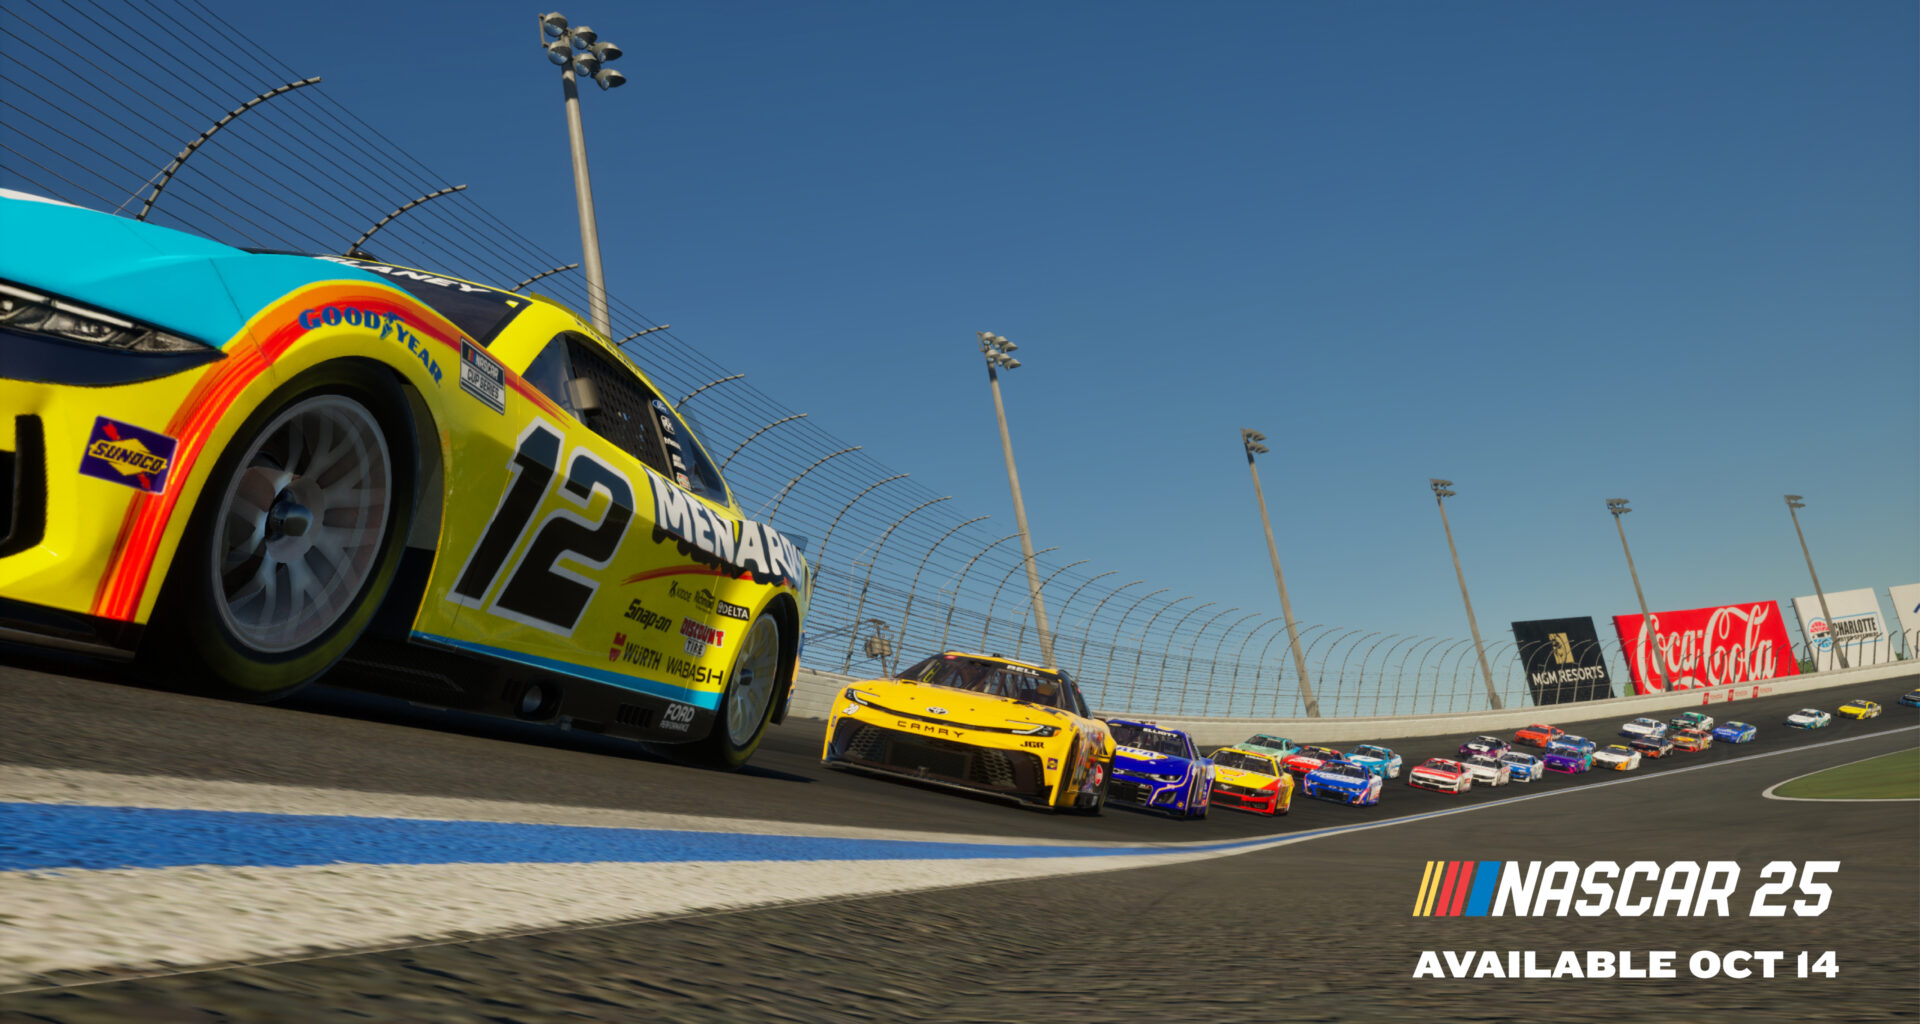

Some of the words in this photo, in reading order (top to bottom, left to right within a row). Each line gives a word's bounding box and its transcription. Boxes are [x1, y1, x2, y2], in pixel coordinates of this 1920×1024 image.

[298, 306, 443, 385] GOODYEAR
[467, 368, 480, 385] CUP
[480, 377, 499, 400] SERIES
[92, 441, 165, 474] SUNOCO
[445, 415, 636, 639] 12
[624, 597, 673, 633] Snap-on
[722, 602, 749, 620] DELTA
[680, 616, 725, 648] DISCOUNT
[1832, 617, 1877, 636] CHARLOTTE
[1636, 602, 1777, 695] Coca-Cola
[623, 641, 663, 671] WÜRTH
[666, 655, 724, 686] WABASH
[1006, 664, 1040, 677] BELL
[1531, 670, 1559, 686] MGM
[1558, 665, 1605, 683] RESORTS
[663, 703, 696, 723] FORD
[896, 720, 965, 739] CAMRY
[1142, 727, 1179, 738] ELLIOTT
[1019, 740, 1046, 749] JGR
